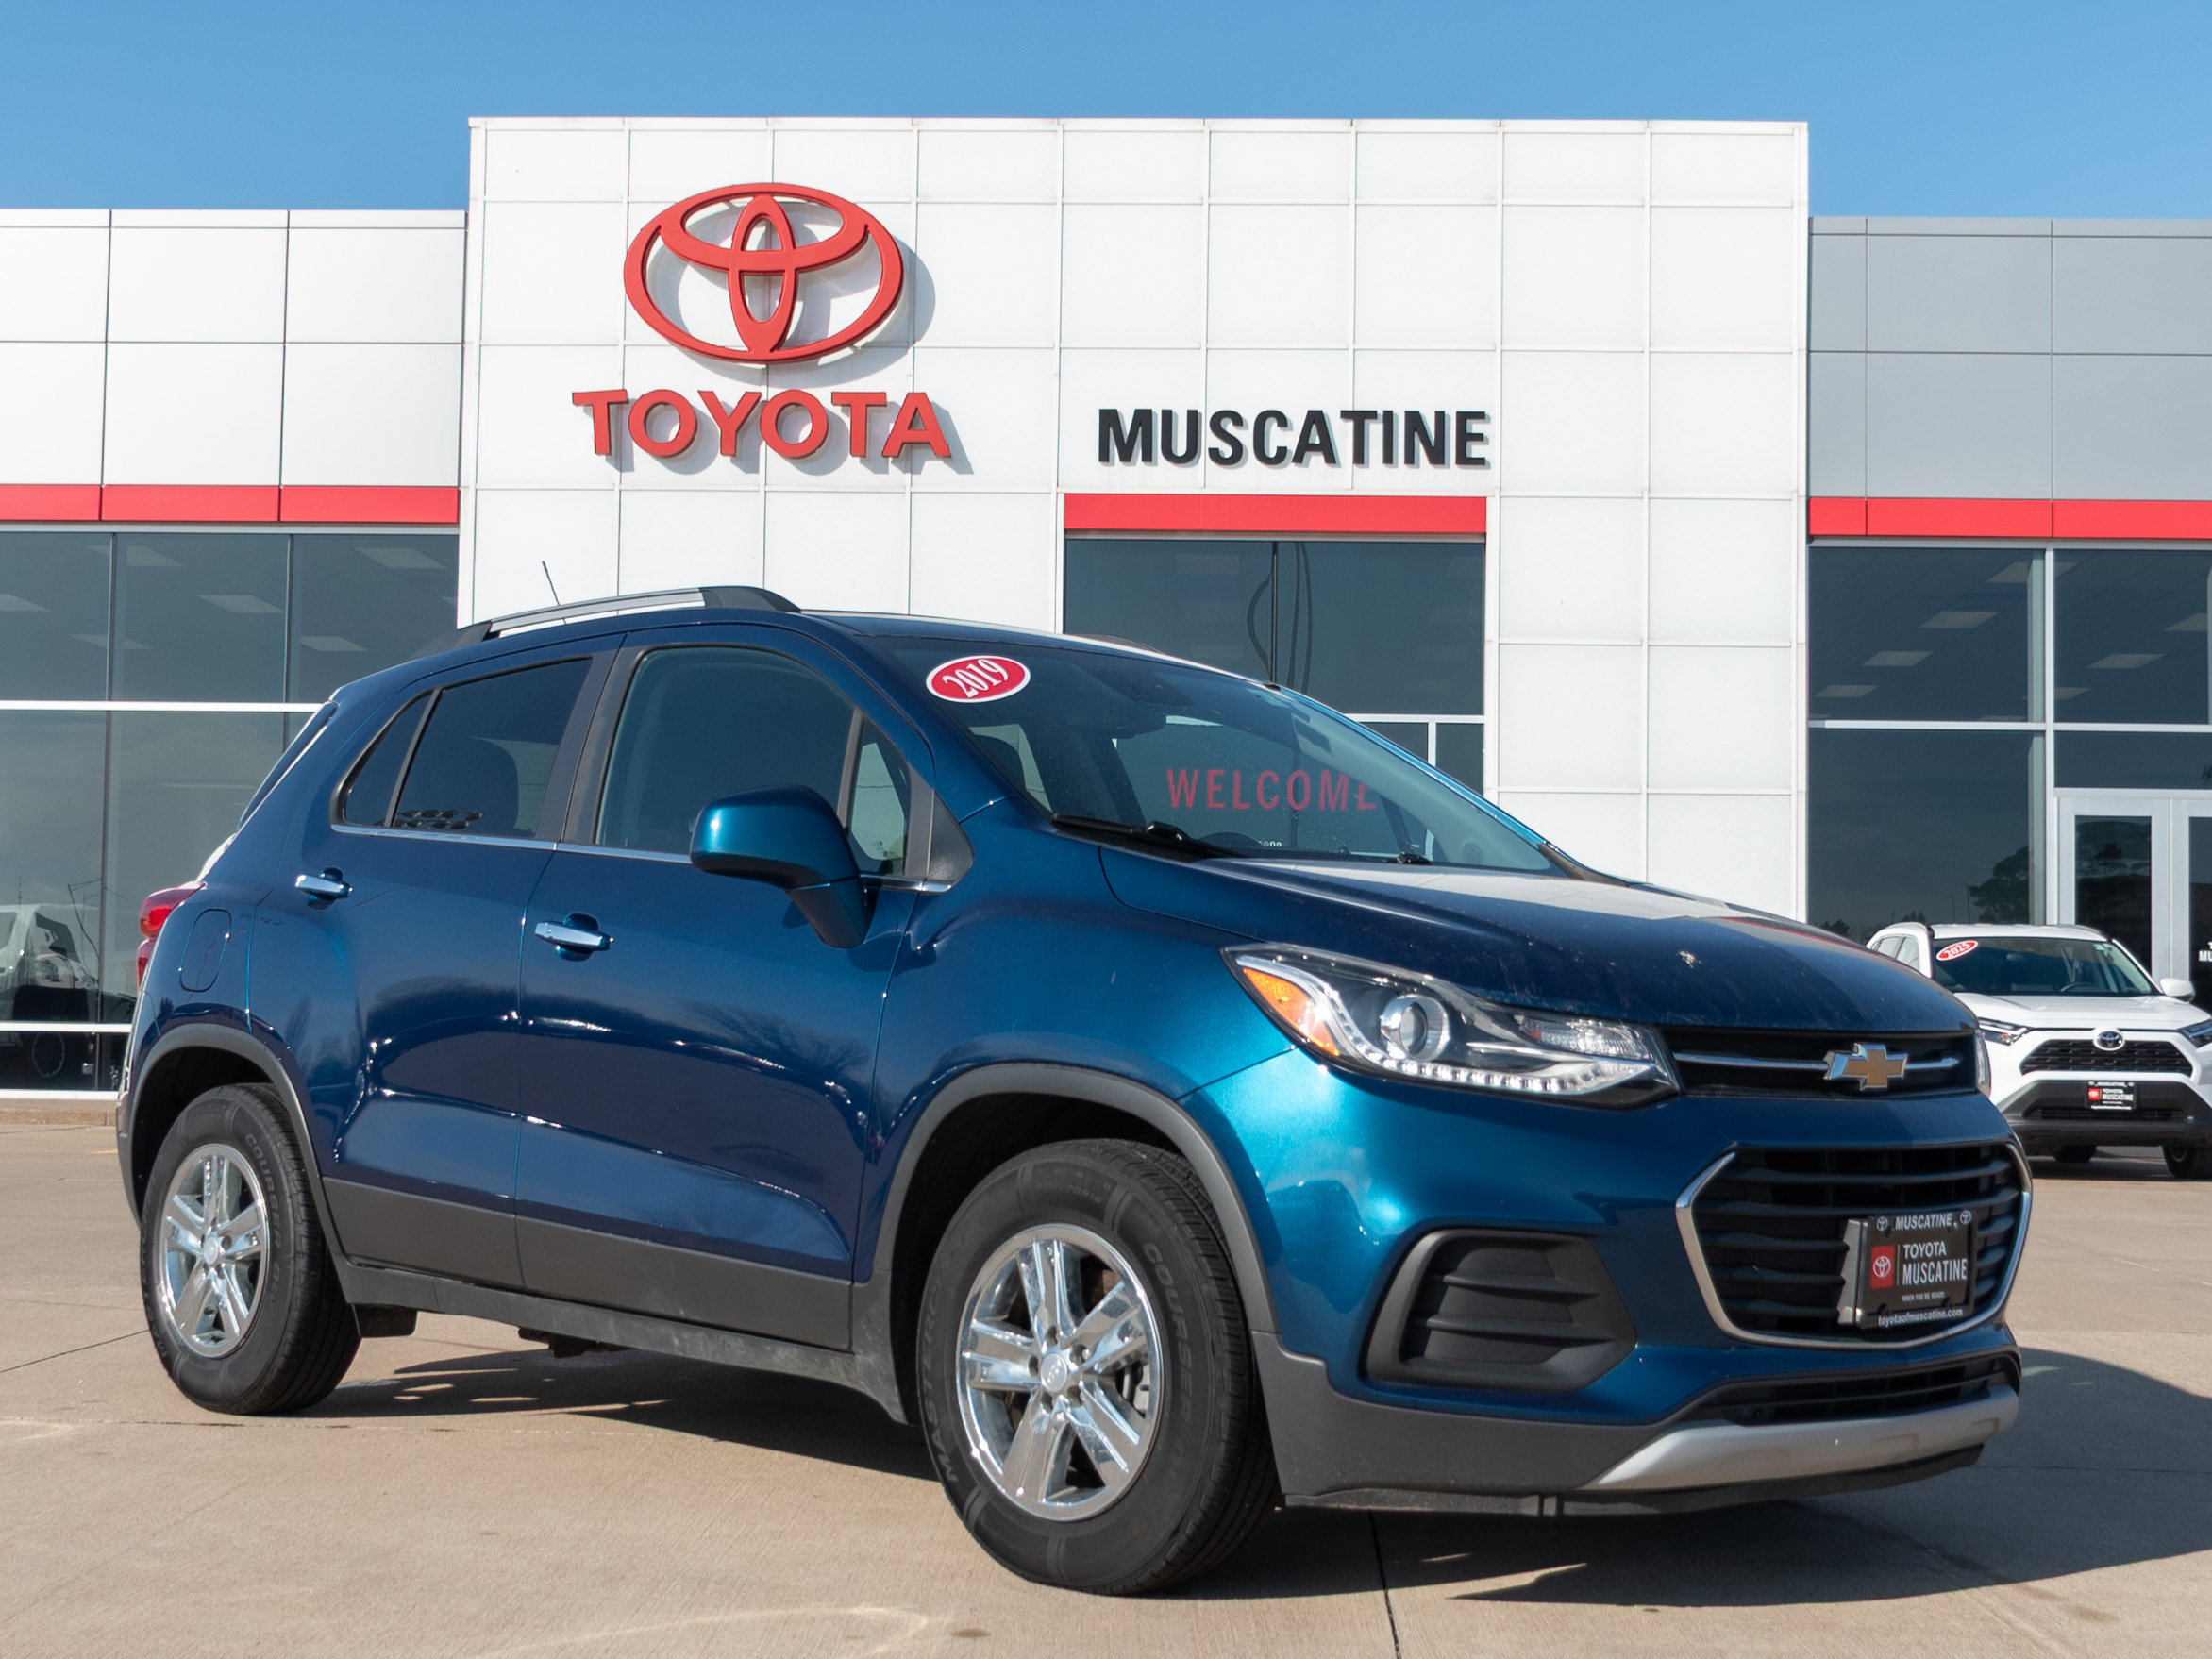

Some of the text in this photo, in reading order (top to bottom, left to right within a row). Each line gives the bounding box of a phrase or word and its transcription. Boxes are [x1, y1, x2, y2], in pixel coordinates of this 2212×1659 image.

[572, 389, 951, 458] TOYOTA
[1098, 408, 1488, 466] MUSCATINE
[942, 659, 1009, 698] 2019
[1166, 768, 1376, 812] WELCOME
[1895, 1213, 1952, 1231] MUSCATINE
[1903, 1241, 1947, 1259] TOYOTA
[1902, 1258, 1968, 1285] MUSCATINE
